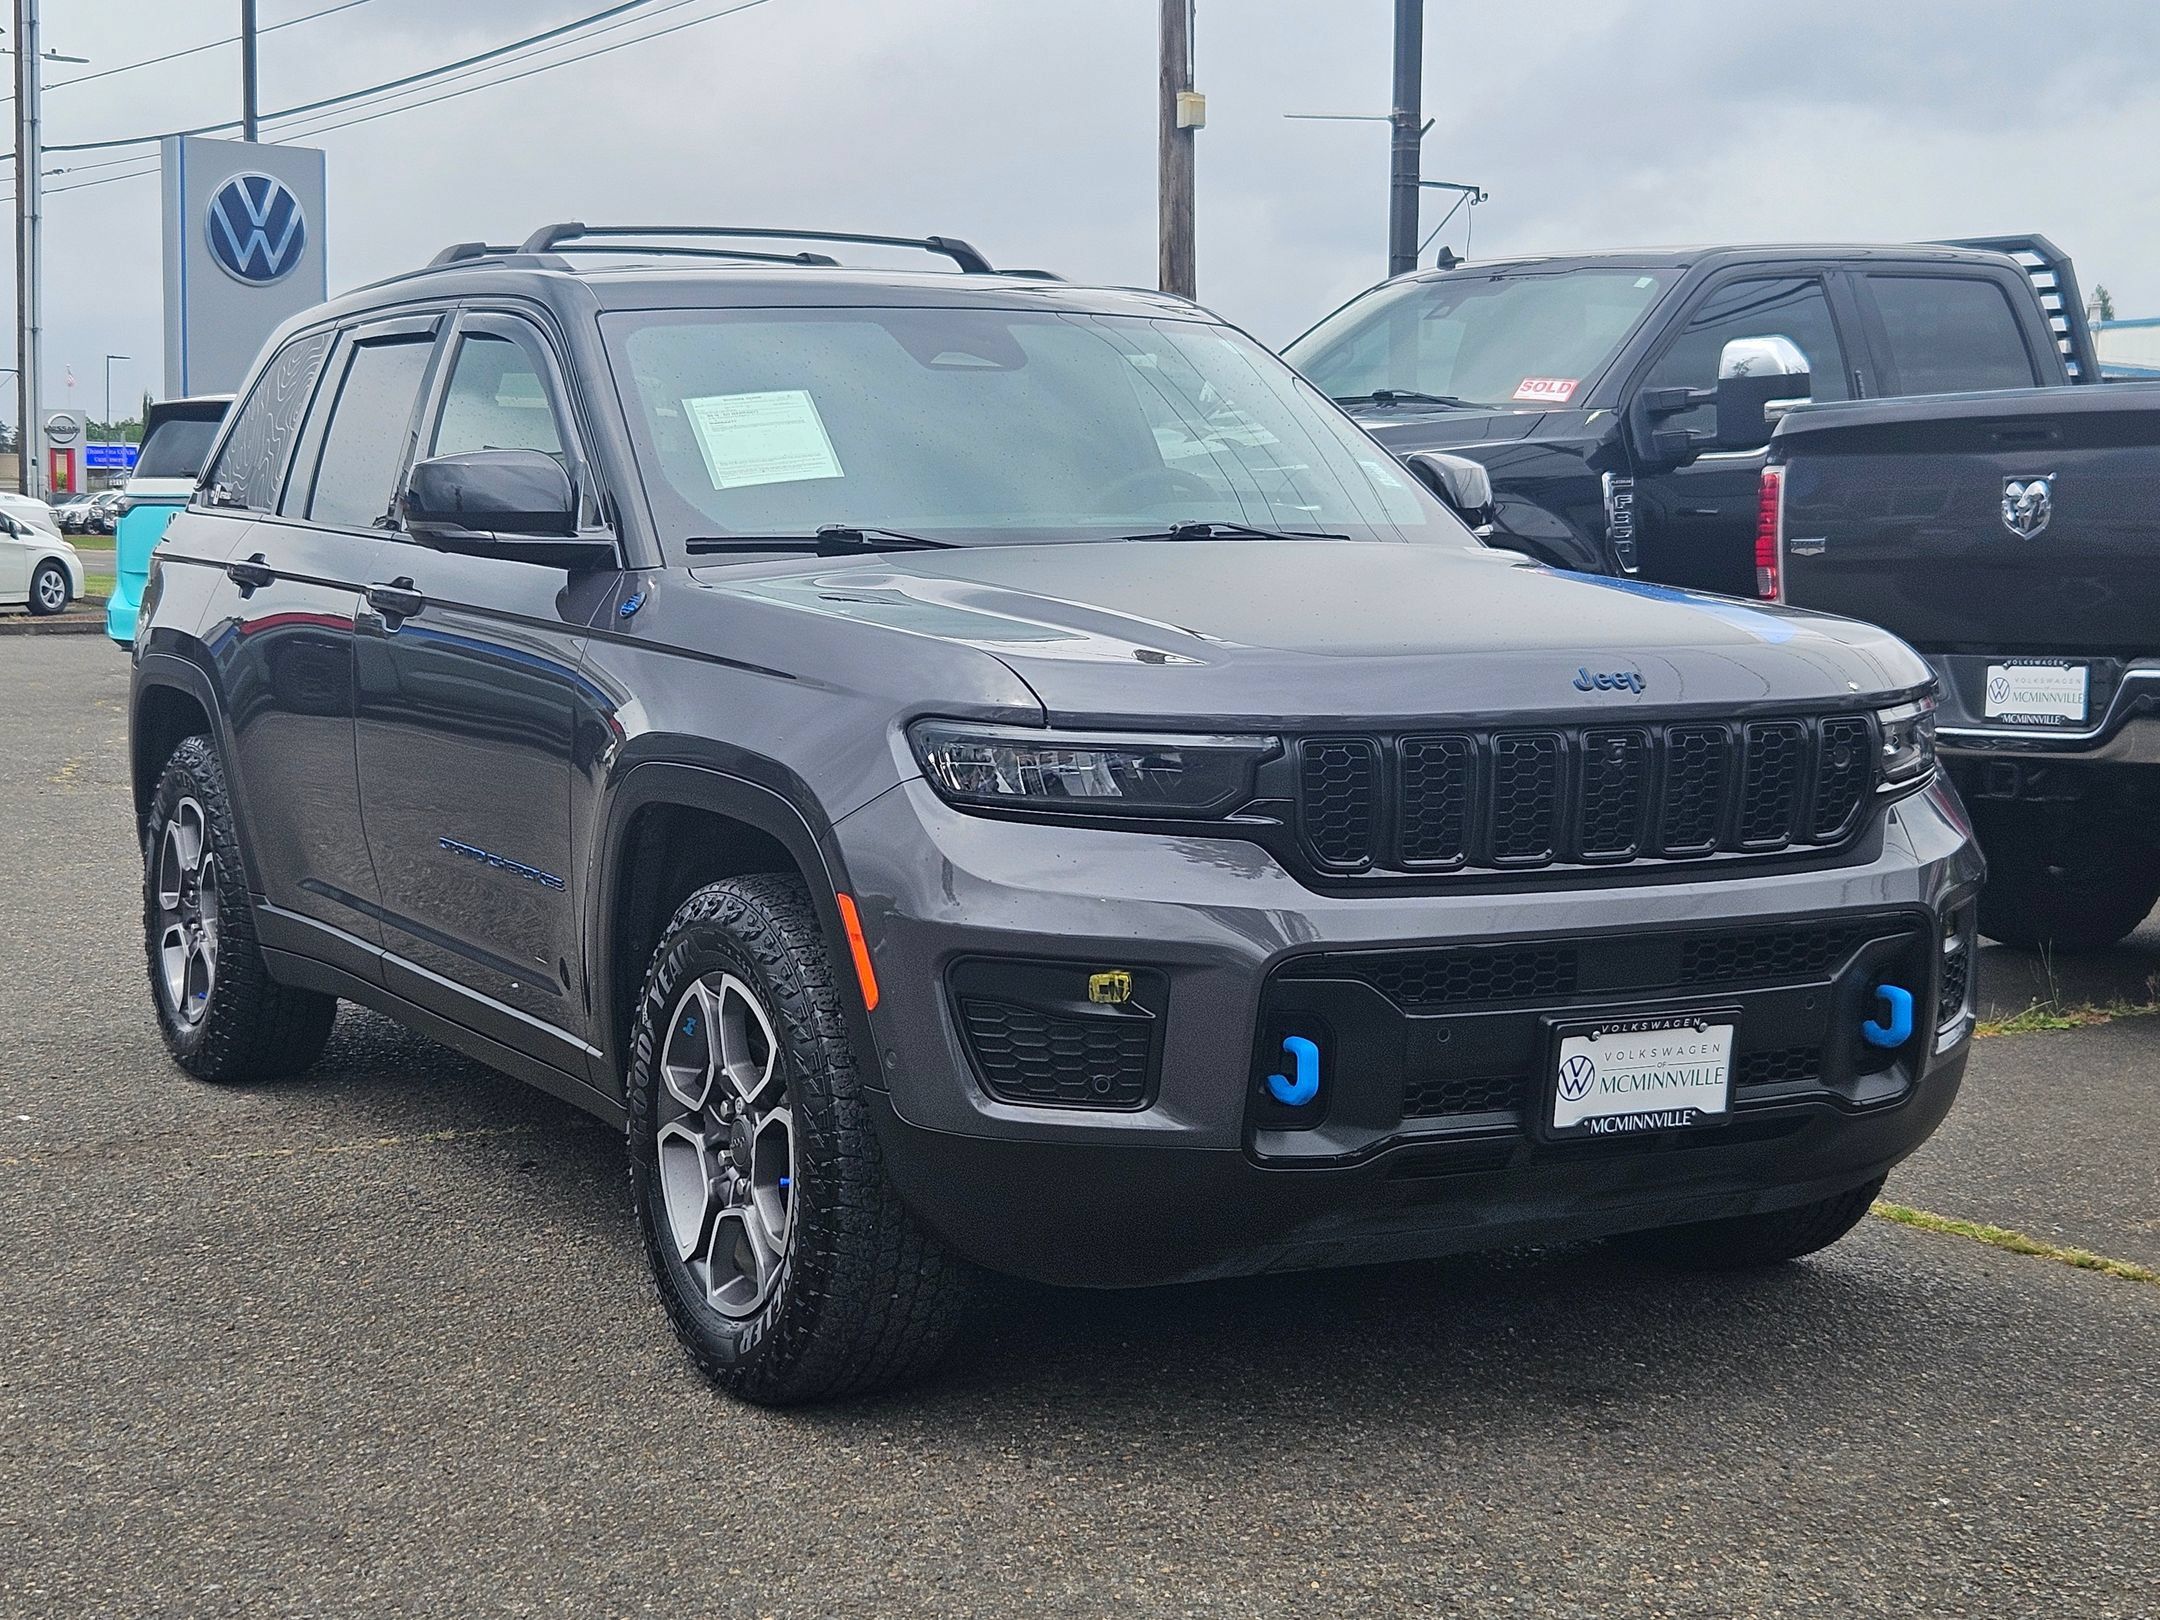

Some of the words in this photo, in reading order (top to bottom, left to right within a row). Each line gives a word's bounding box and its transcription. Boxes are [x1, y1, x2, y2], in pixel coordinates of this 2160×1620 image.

[1520, 381, 1572, 394] SOLD
[1573, 667, 1647, 694] Jeep
[2012, 692, 2083, 704] MCMINNVILLE
[2003, 715, 2061, 725] MCMINNVILLE
[1601, 1018, 1702, 1034] VOLKSWAGEN
[1604, 1043, 1722, 1062] VOLKSWAGEN
[1599, 1067, 1725, 1095] MCMINNVILLE
[1590, 1110, 1692, 1134] MCMINNVILLE
